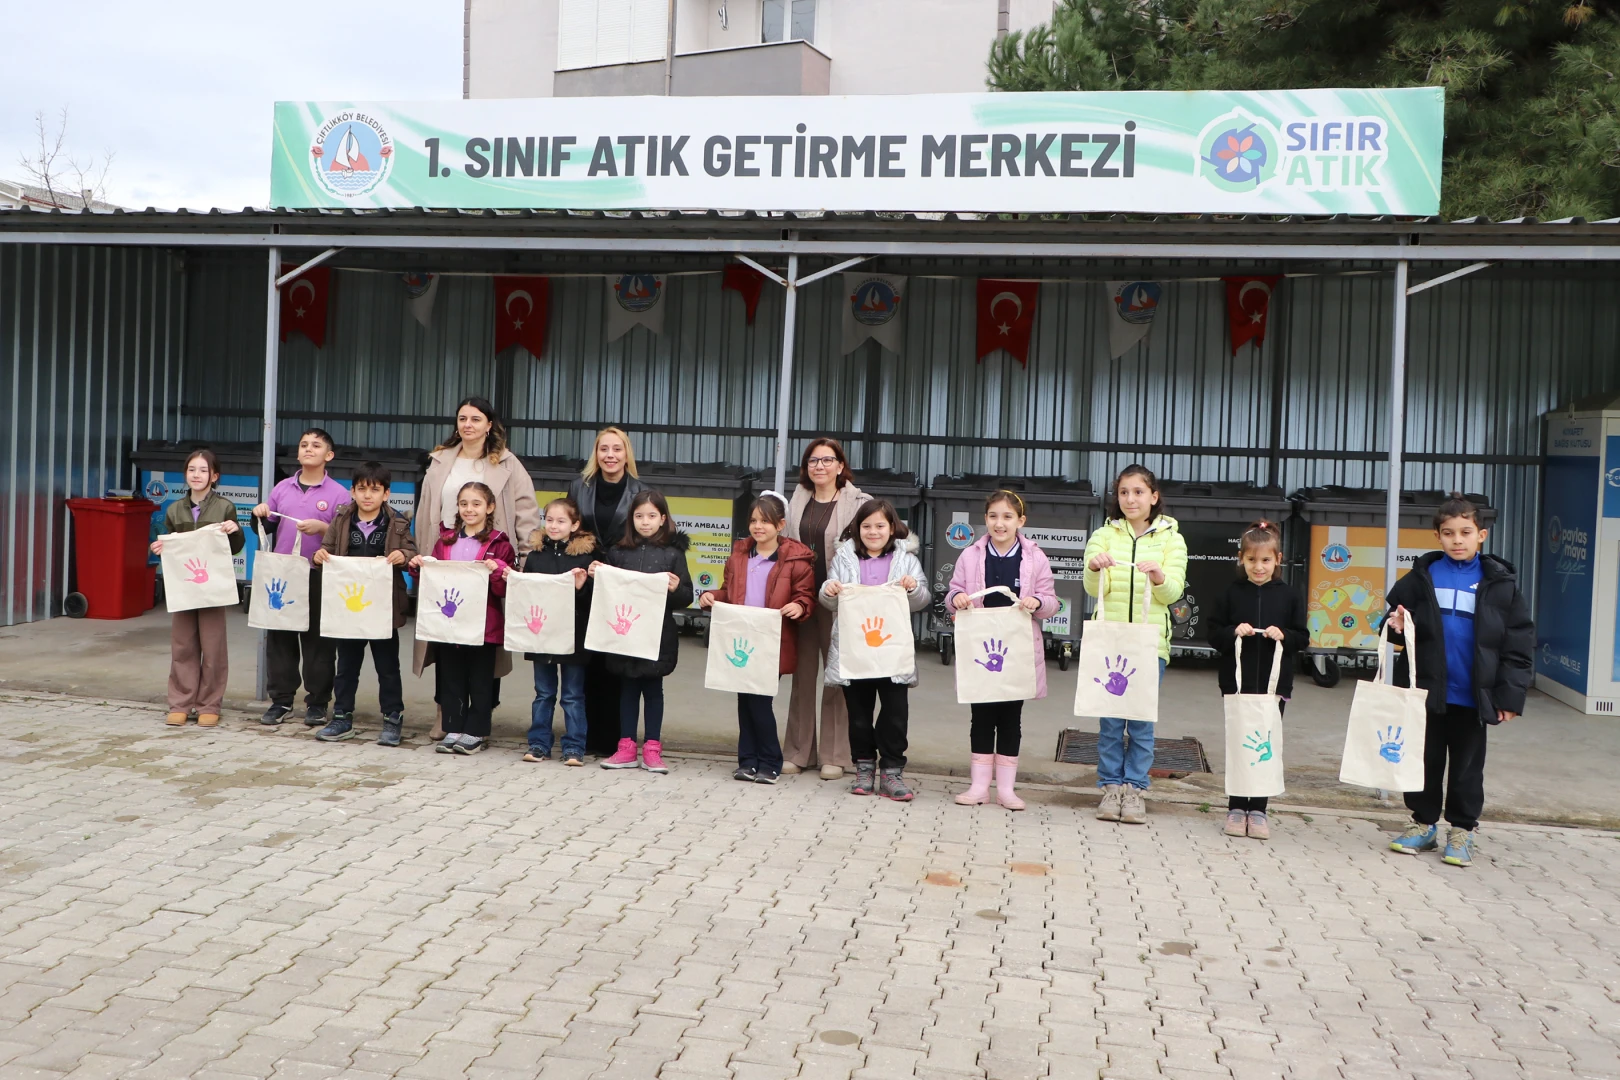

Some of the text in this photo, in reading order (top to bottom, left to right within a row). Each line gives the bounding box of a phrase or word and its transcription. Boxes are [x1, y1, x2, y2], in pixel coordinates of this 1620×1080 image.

[316, 112, 391, 145] ÇİFTLİKKÖY BELEDİYESİ
[1286, 121, 1382, 151] SIFIR
[424, 120, 1137, 178] 1. SINIF ATIK GETİRME MERKEZİ
[1285, 155, 1381, 186] ATIK
[677, 520, 730, 530] STİK AMBALAJ
[1564, 544, 1587, 561] maya
